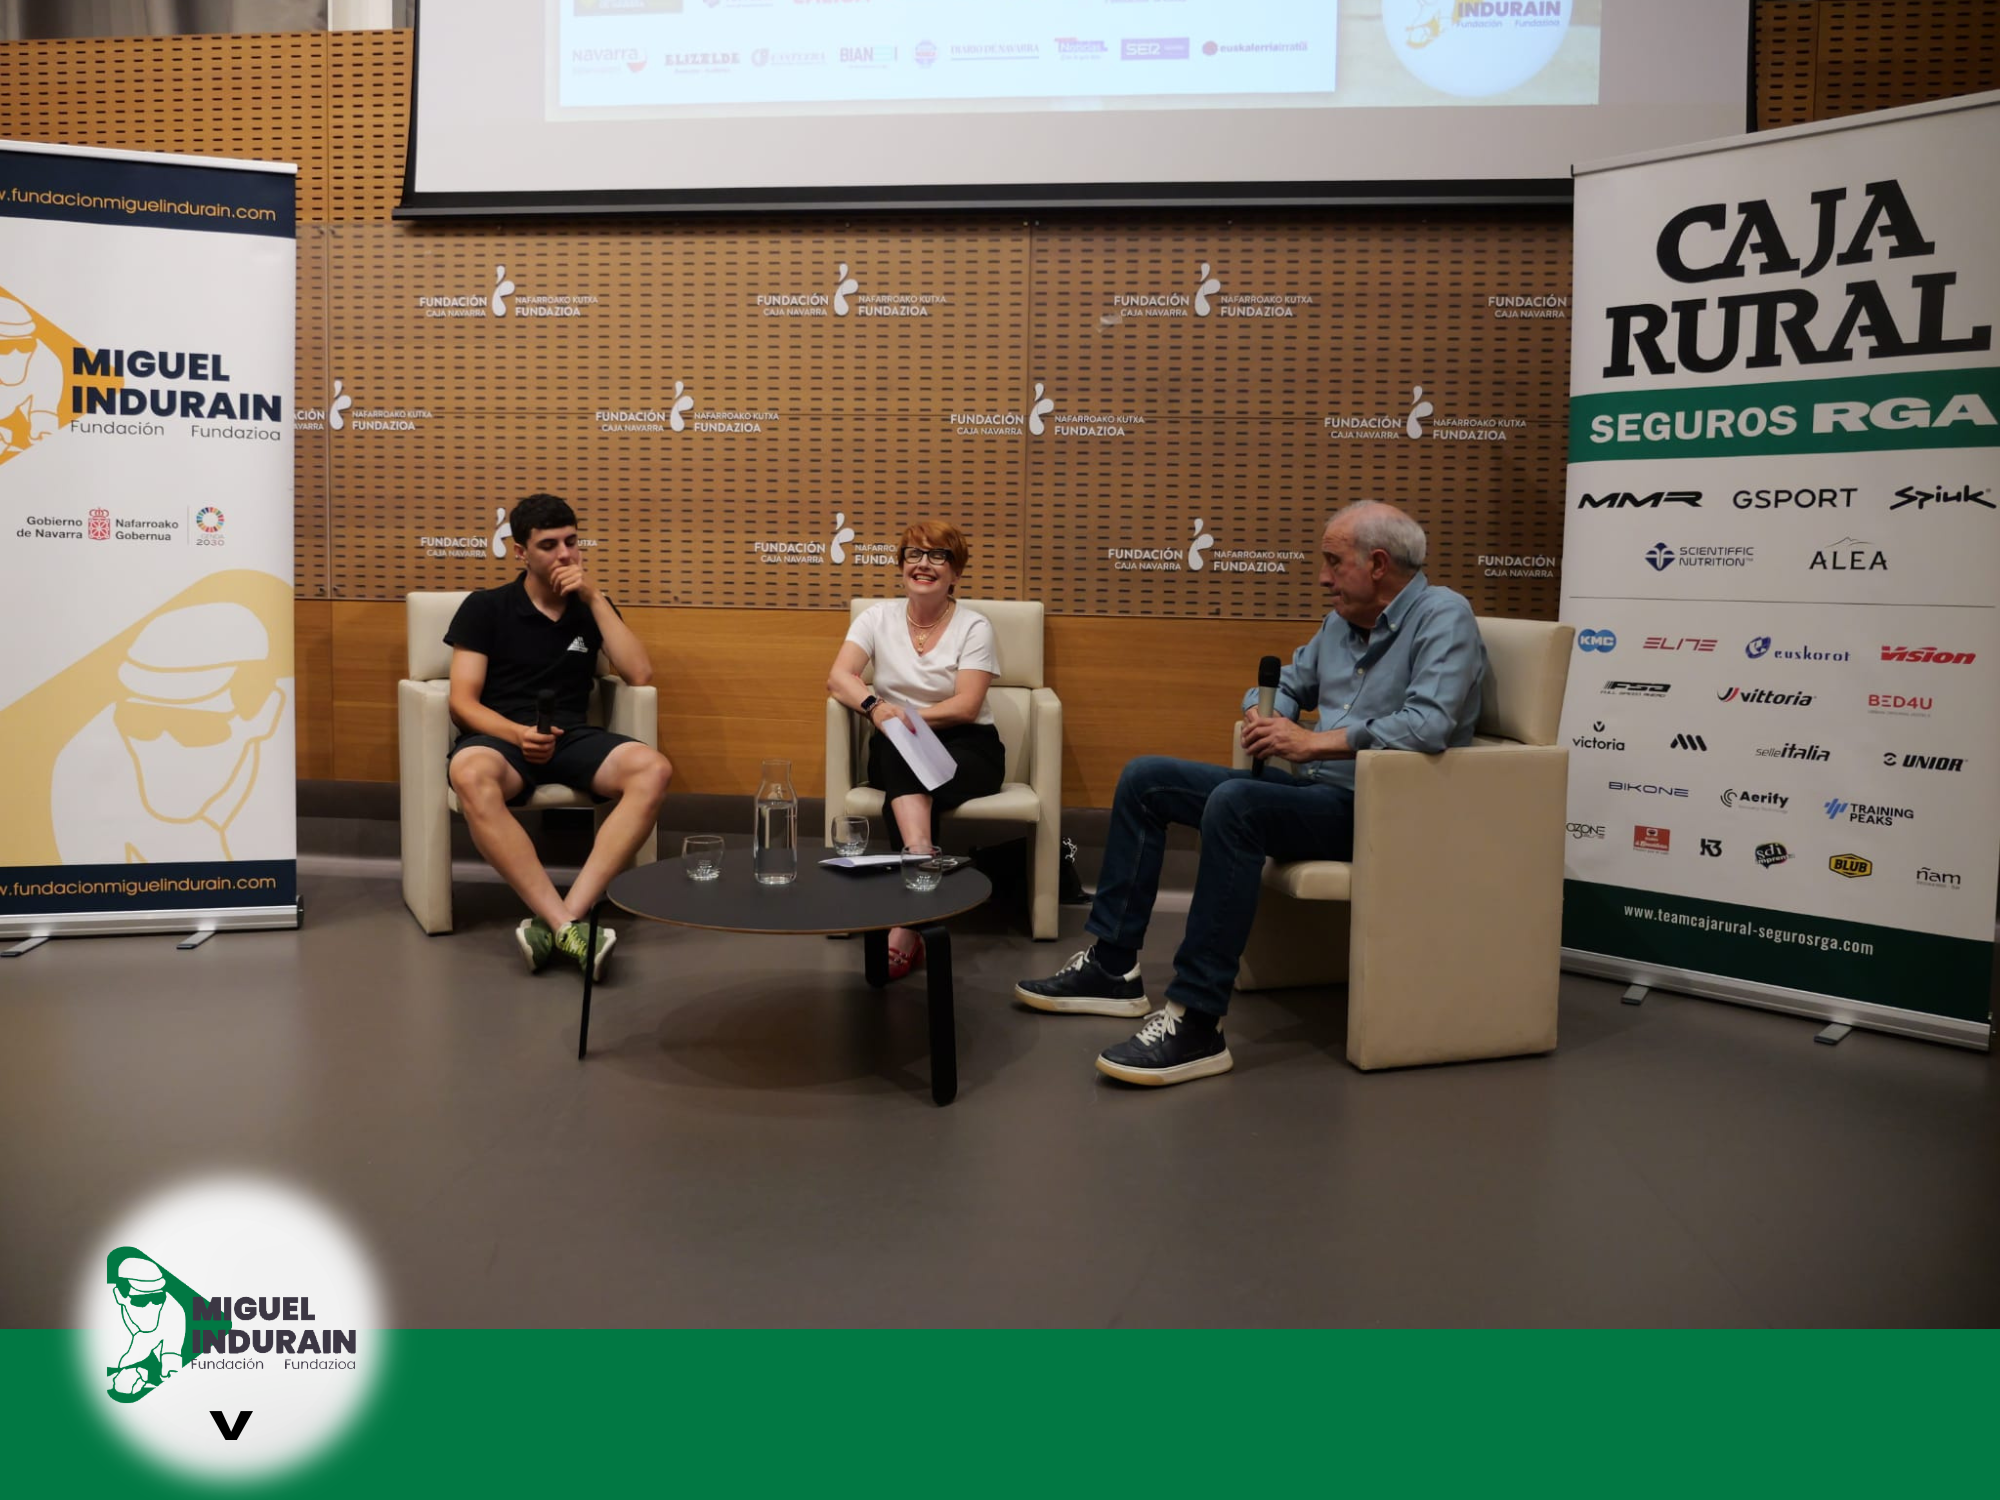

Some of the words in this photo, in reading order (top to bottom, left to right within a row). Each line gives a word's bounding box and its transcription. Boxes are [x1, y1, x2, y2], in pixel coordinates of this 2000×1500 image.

[1457, 0, 1562, 17] INDURAIN
[572, 48, 639, 62] Navarra
[1656, 179, 1936, 284] CAJA
[419, 294, 487, 307] FUNDACIÓN
[515, 296, 571, 304] NAFARROAKO
[572, 296, 598, 304] KUTXA
[757, 293, 829, 306] FUNDACIÓN
[858, 295, 917, 304] NAFARROAKO
[919, 295, 947, 304] KUTXA
[1113, 293, 1190, 306] FUNDACIÓN
[1220, 295, 1282, 304] NAFARROAKO
[1284, 296, 1313, 304] KUTXA
[1487, 293, 1567, 307] FUNDACIÓN
[426, 309, 446, 317] CAJA
[515, 306, 581, 317] FUNDAZIOA
[763, 308, 785, 316] CAJA
[788, 308, 827, 316] NAVARRA
[858, 306, 928, 317] FUNDAZIOA
[1120, 308, 1142, 317] CAJA
[1145, 309, 1188, 317] NAVARRA
[1220, 306, 1293, 317] FUNDAZIOA
[1494, 310, 1518, 318] CAJA
[1520, 310, 1565, 318] NAVARRA
[1603, 271, 1992, 379] RURAL
[72, 347, 230, 382] MIGUEL
[72, 386, 282, 422] INDURAIN
[352, 410, 406, 418] NAFARROAKO
[596, 409, 666, 422] FUNDACIÓN
[694, 412, 751, 420] NAFARROAKO
[950, 412, 1024, 425] FUNDACIÓN
[1054, 415, 1115, 423] NAFARROAKO
[1116, 416, 1145, 424] KUTXA
[1590, 405, 1798, 443] SEGUROS
[1812, 393, 1999, 434] RGA
[352, 421, 416, 431] FUNDAZIOA
[694, 422, 761, 433] FUNDAZIOA
[1324, 415, 1401, 428] FUNDACIÓN
[1433, 419, 1496, 427] NAFARROAKO
[1499, 420, 1526, 428] KUTXA
[70, 419, 165, 436] Fundación
[190, 424, 281, 441] Fundazioa
[601, 424, 624, 432] CAJA
[624, 424, 664, 432] NAVARRA
[956, 427, 979, 435] CAJA
[980, 427, 1023, 435] NAVARRA
[1054, 426, 1125, 436] FUNDAZIOA
[1330, 430, 1353, 439] CAJA
[1355, 431, 1399, 439] NAVARRA
[1433, 429, 1507, 441] FUNDAZIOA
[1577, 491, 1703, 509] MMR
[1732, 487, 1859, 509] GSPORT
[1889, 484, 1997, 510] Spiuk
[26, 516, 83, 527] Gobierno
[115, 519, 179, 529] Nafarroako
[16, 529, 32, 538] de
[35, 529, 83, 539] Navarra
[115, 531, 172, 541] Gobernua
[420, 535, 488, 548] FUNDACIÓN
[754, 541, 826, 553] FUNDACIÓN
[855, 543, 898, 552] NAFARRO
[448, 550, 487, 558] NAVARRA
[1107, 547, 1183, 560] FUNDACIÓN
[1213, 550, 1275, 559] NAFARROAKO
[1276, 551, 1305, 560] KUTXA
[1679, 547, 1754, 556] SCIENTIFFIC
[760, 555, 782, 563] CAJA
[783, 555, 824, 564] NAVARRA
[855, 554, 899, 565] FUNDA
[1477, 554, 1556, 567] FUNDACIÓN
[1809, 550, 1888, 570] ALEA
[1114, 562, 1137, 570] CAJA
[1138, 562, 1181, 570] NAVARRA
[1213, 561, 1286, 572] FUNDAZIOA
[1484, 568, 1508, 577] CAJA
[1509, 569, 1554, 578] NAVARRA
[1580, 635, 1614, 646] KMC
[1643, 637, 1718, 652] ELITE
[1881, 645, 1976, 665] Vision
[1740, 688, 1813, 707] vittoria
[1868, 694, 1933, 710] BED4U
[1572, 736, 1625, 751] victoria
[1902, 754, 1964, 772] UNIOR
[1608, 781, 1689, 798] BIKONE
[1740, 791, 1789, 809] Aerify
[1850, 803, 1915, 819] TRAINING
[1849, 813, 1893, 826] PEAKS
[1834, 859, 1868, 873] BLUB
[1916, 866, 1962, 884] ñam
[1624, 905, 1874, 956] www.teamcajarural-segurosrga.com
